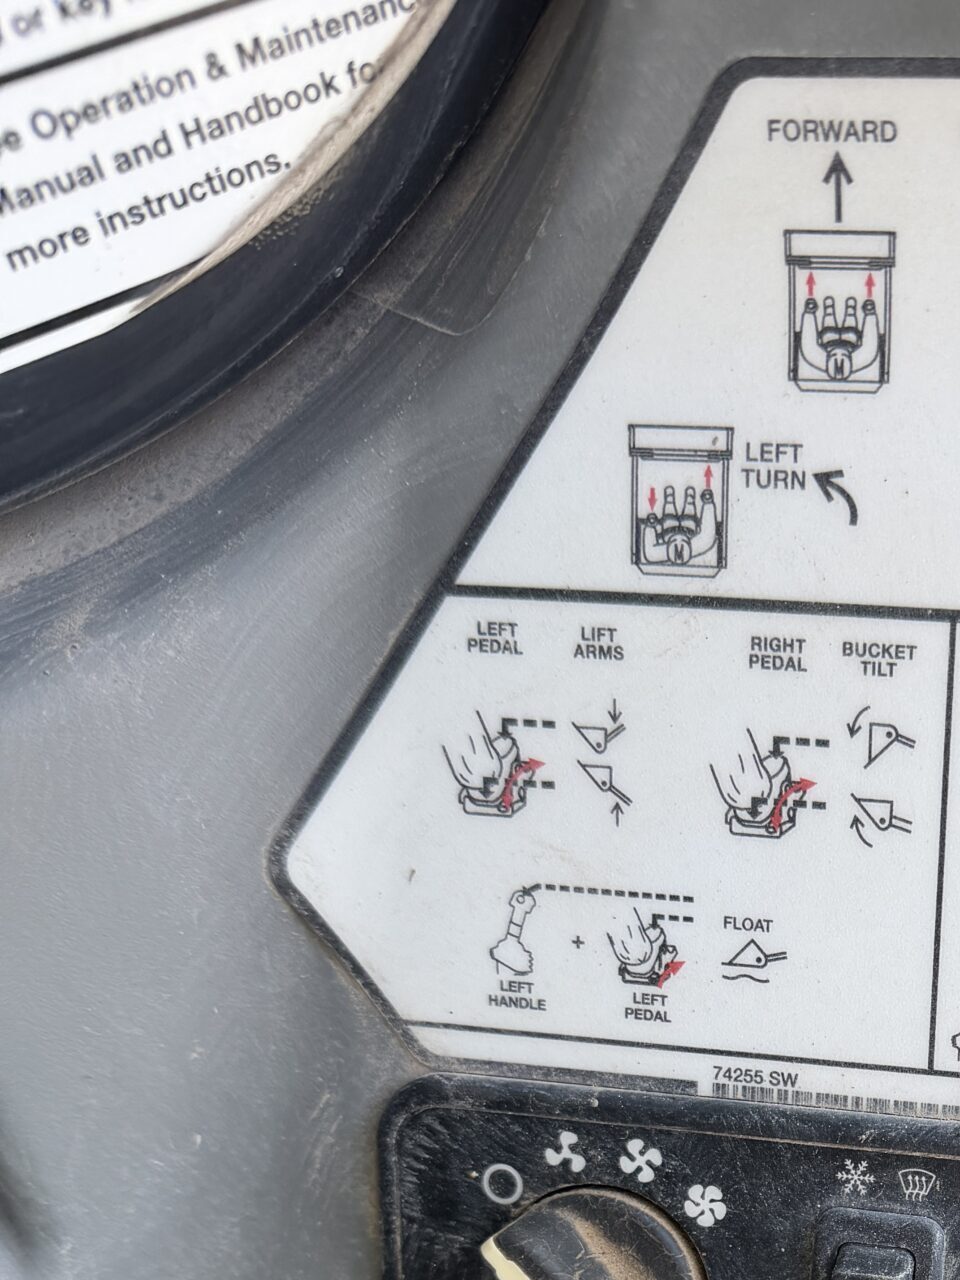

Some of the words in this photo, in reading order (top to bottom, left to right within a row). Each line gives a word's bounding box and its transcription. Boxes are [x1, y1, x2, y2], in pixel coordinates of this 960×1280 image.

[11, 7, 43, 38] or
[30, 66, 197, 140] Operation
[205, 52, 228, 81] &
[113, 129, 174, 174] and
[179, 71, 342, 149] Handbook
[346, 60, 384, 88] fo
[767, 118, 898, 143] FORWARD
[5, 226, 90, 270] more
[95, 152, 291, 238] instructions.
[745, 441, 804, 464] LEFT
[740, 468, 806, 490] TURN
[476, 621, 518, 638] LEFT
[580, 626, 618, 643] LIFT
[467, 637, 524, 655] PEDAL
[573, 643, 625, 661] ARMS
[750, 635, 807, 654] RIGHT
[842, 641, 918, 661] BUCKET
[748, 653, 808, 673] PEDAL
[860, 660, 898, 678] TILT
[723, 915, 774, 933] FLOAT
[499, 980, 535, 994] LEFT
[488, 994, 547, 1012] HANDLE
[632, 992, 669, 1007] LEFT
[624, 1007, 672, 1023] PEDAL
[713, 1065, 765, 1085] 74255
[768, 1070, 799, 1088] SW
